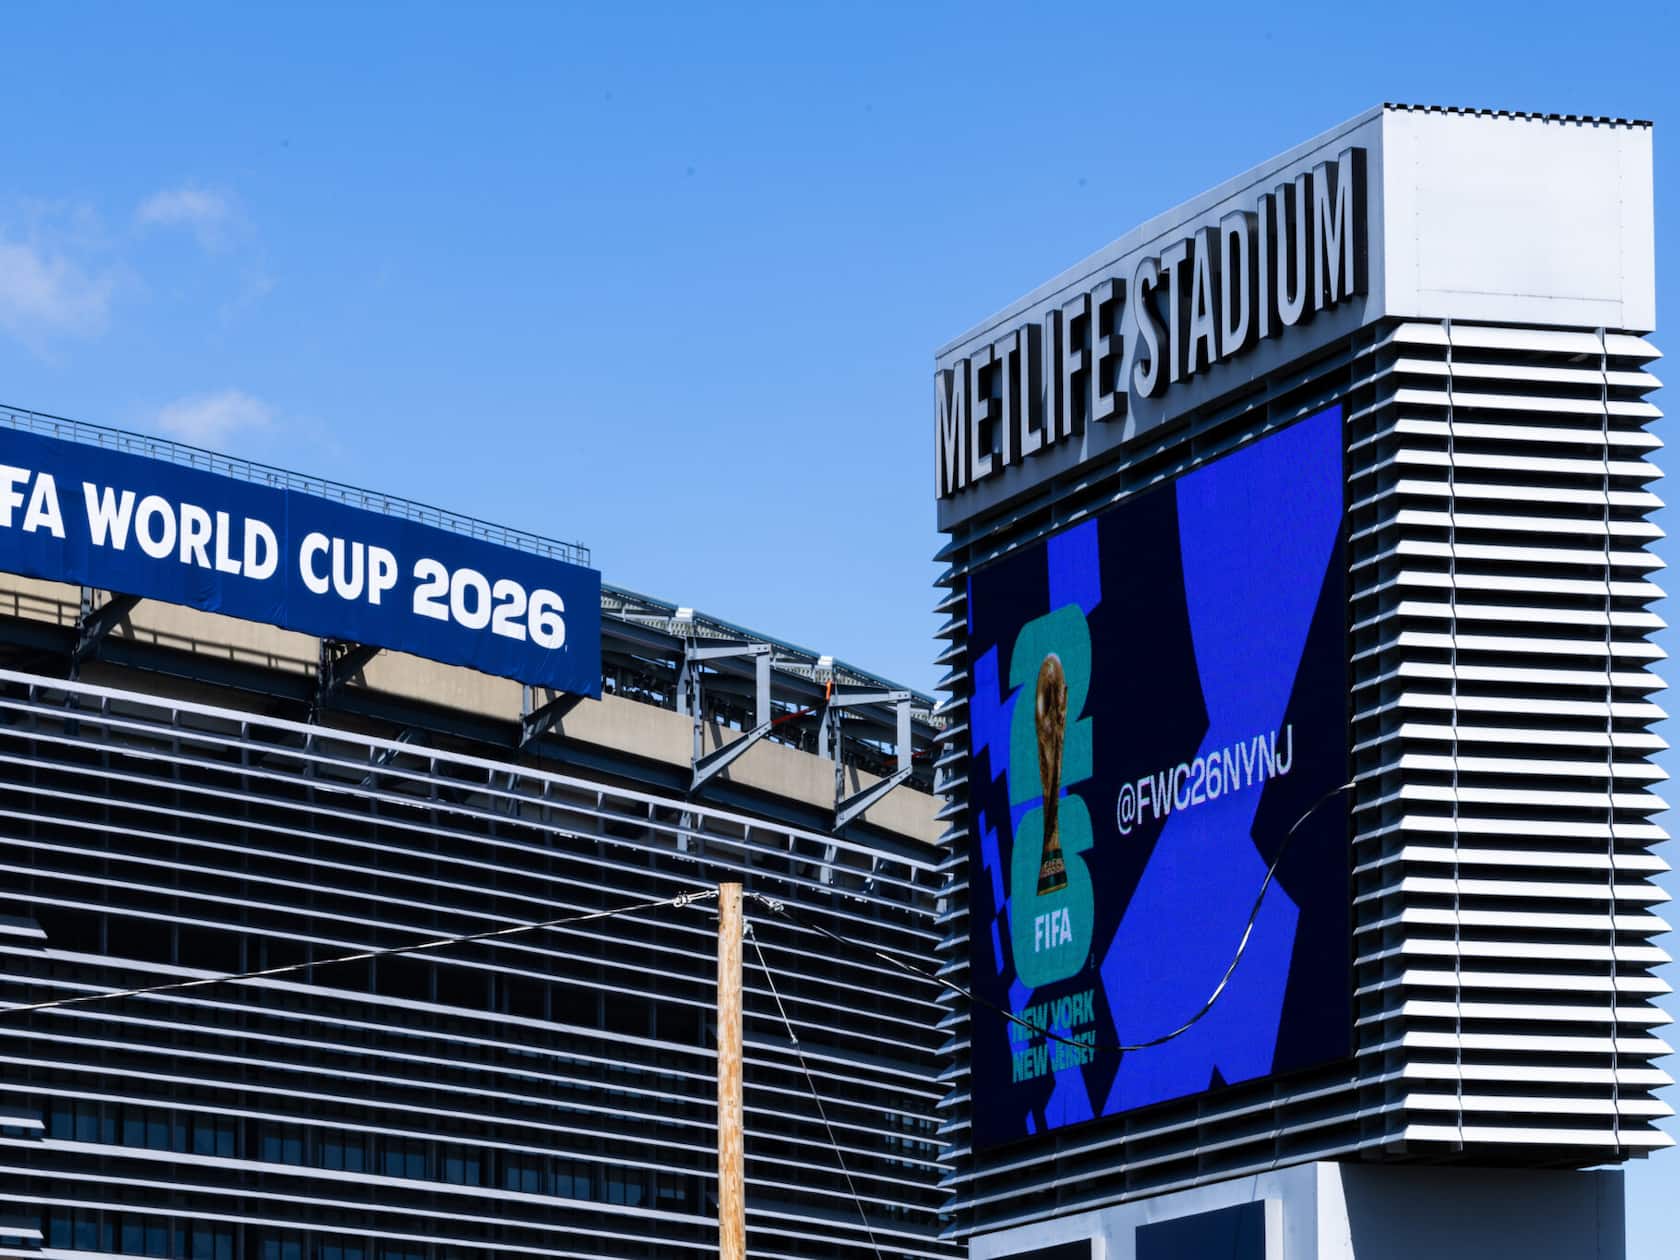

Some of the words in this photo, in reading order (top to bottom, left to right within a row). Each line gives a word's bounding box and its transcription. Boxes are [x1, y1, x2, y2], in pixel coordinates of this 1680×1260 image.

[935, 278, 1126, 499] METLIFE
[1134, 147, 1366, 398] STADIUM
[82, 481, 279, 580] WORLD
[299, 532, 398, 605] CUP
[413, 558, 566, 650] 2026
[1117, 724, 1293, 835] @FWC26NYNJ
[1034, 907, 1072, 952] FIFA
[1012, 1002, 1048, 1044] NEW
[1050, 989, 1095, 1032] YORK
[1012, 1043, 1048, 1083] NEW
